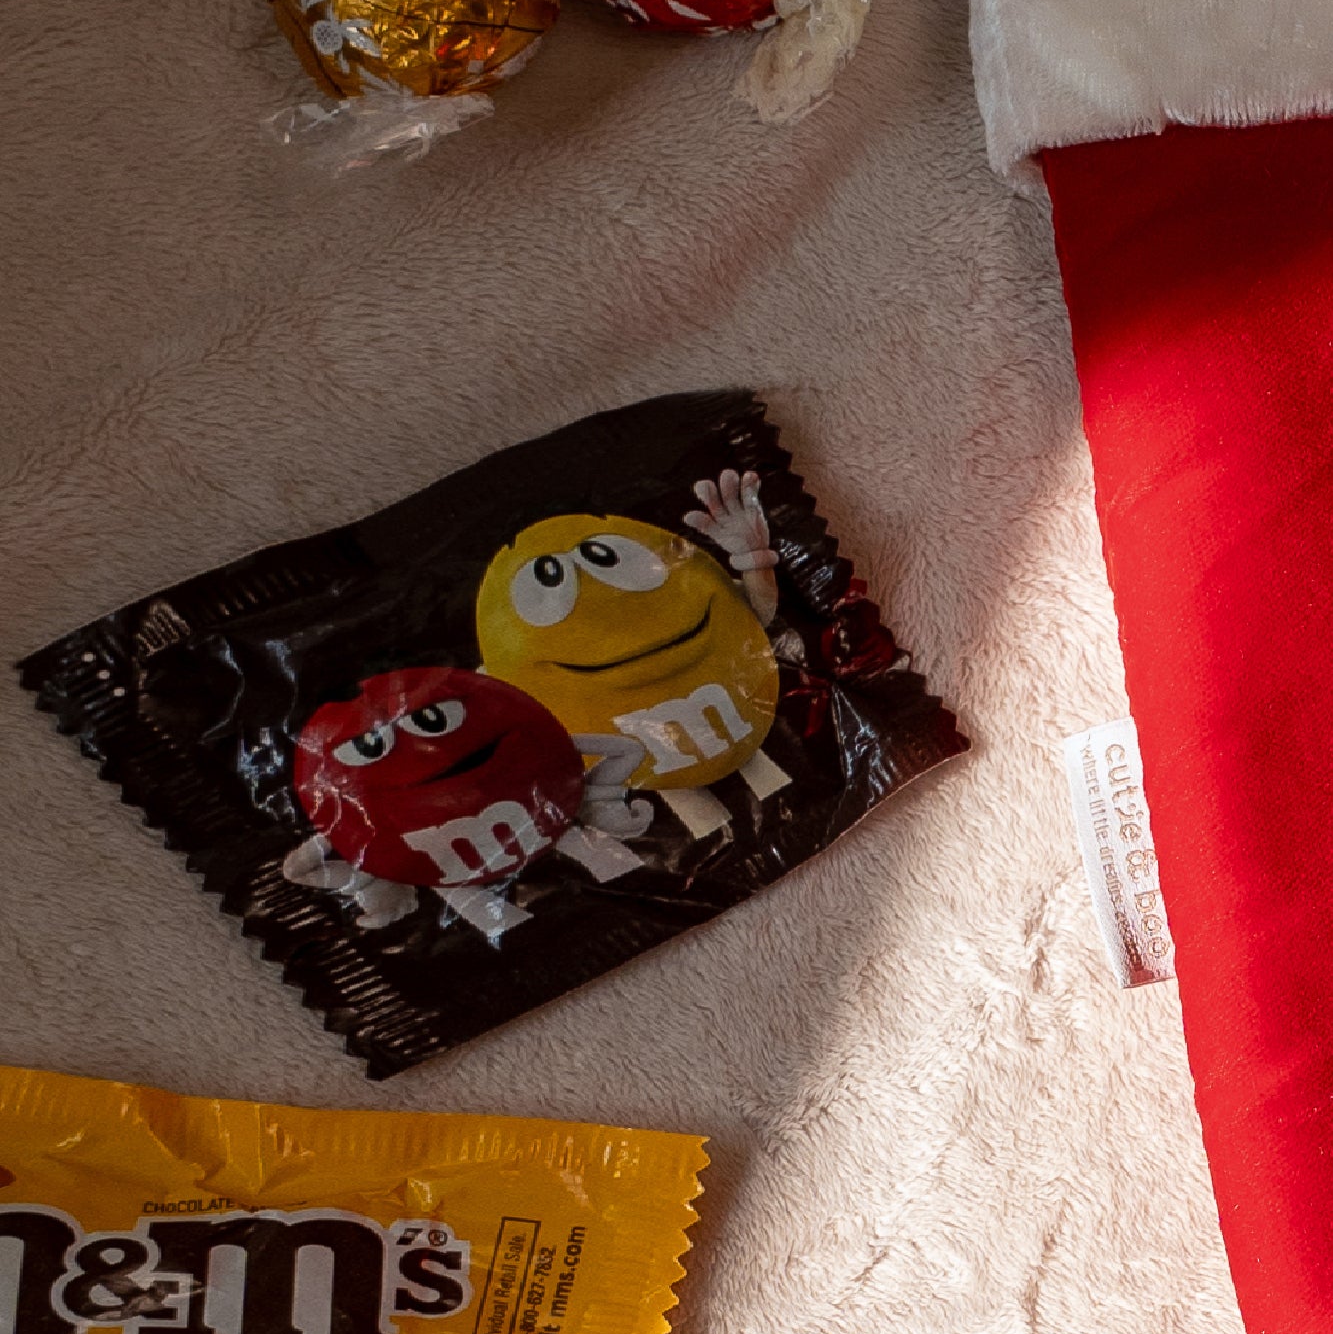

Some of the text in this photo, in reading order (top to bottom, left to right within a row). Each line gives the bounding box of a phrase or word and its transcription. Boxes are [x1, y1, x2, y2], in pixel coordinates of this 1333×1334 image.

[613, 683, 754, 774] m
[400, 800, 552, 884] m
[143, 1197, 235, 1214] CHOCOLATE
[494, 1264, 518, 1298] Retail
[550, 1226, 588, 1318] mms.com
